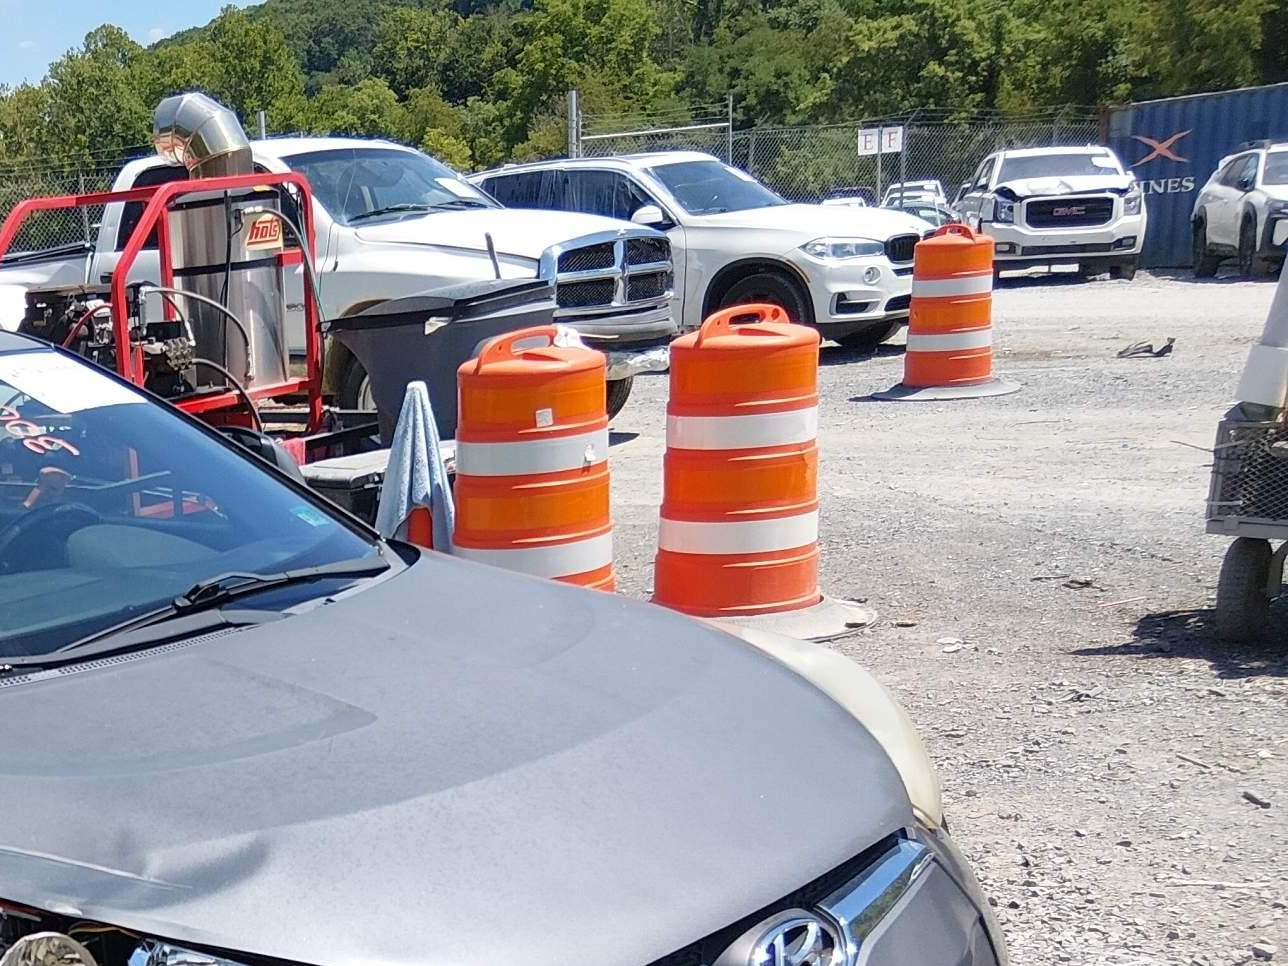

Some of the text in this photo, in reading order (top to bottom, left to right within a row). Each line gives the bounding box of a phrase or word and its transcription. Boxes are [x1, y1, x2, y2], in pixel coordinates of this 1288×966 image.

[863, 133, 873, 150] E
[888, 131, 898, 148] F
[1139, 177, 1195, 194] INES
[1053, 206, 1086, 216] GMC
